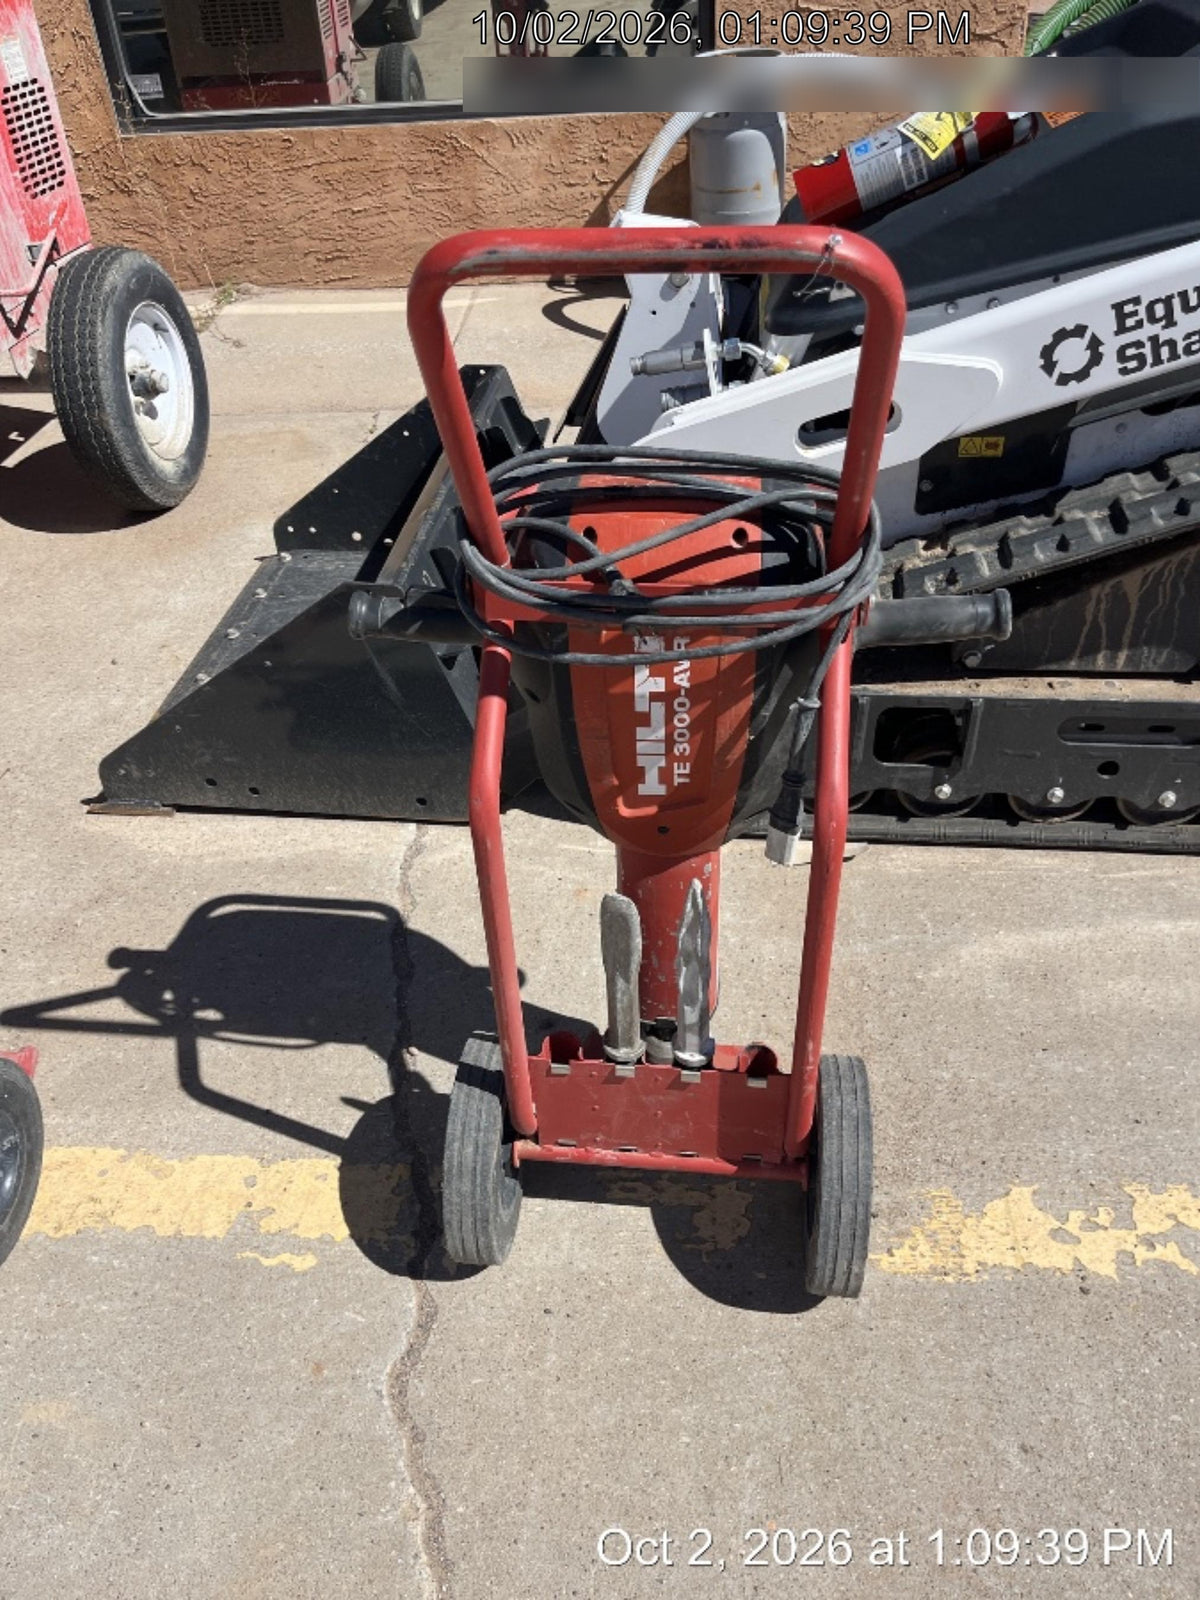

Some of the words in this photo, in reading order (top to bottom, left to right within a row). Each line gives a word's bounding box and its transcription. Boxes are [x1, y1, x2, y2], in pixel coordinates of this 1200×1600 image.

[1110, 285, 1200, 337] Equ
[1116, 329, 1200, 376] Sha
[673, 761, 691, 787] TE
